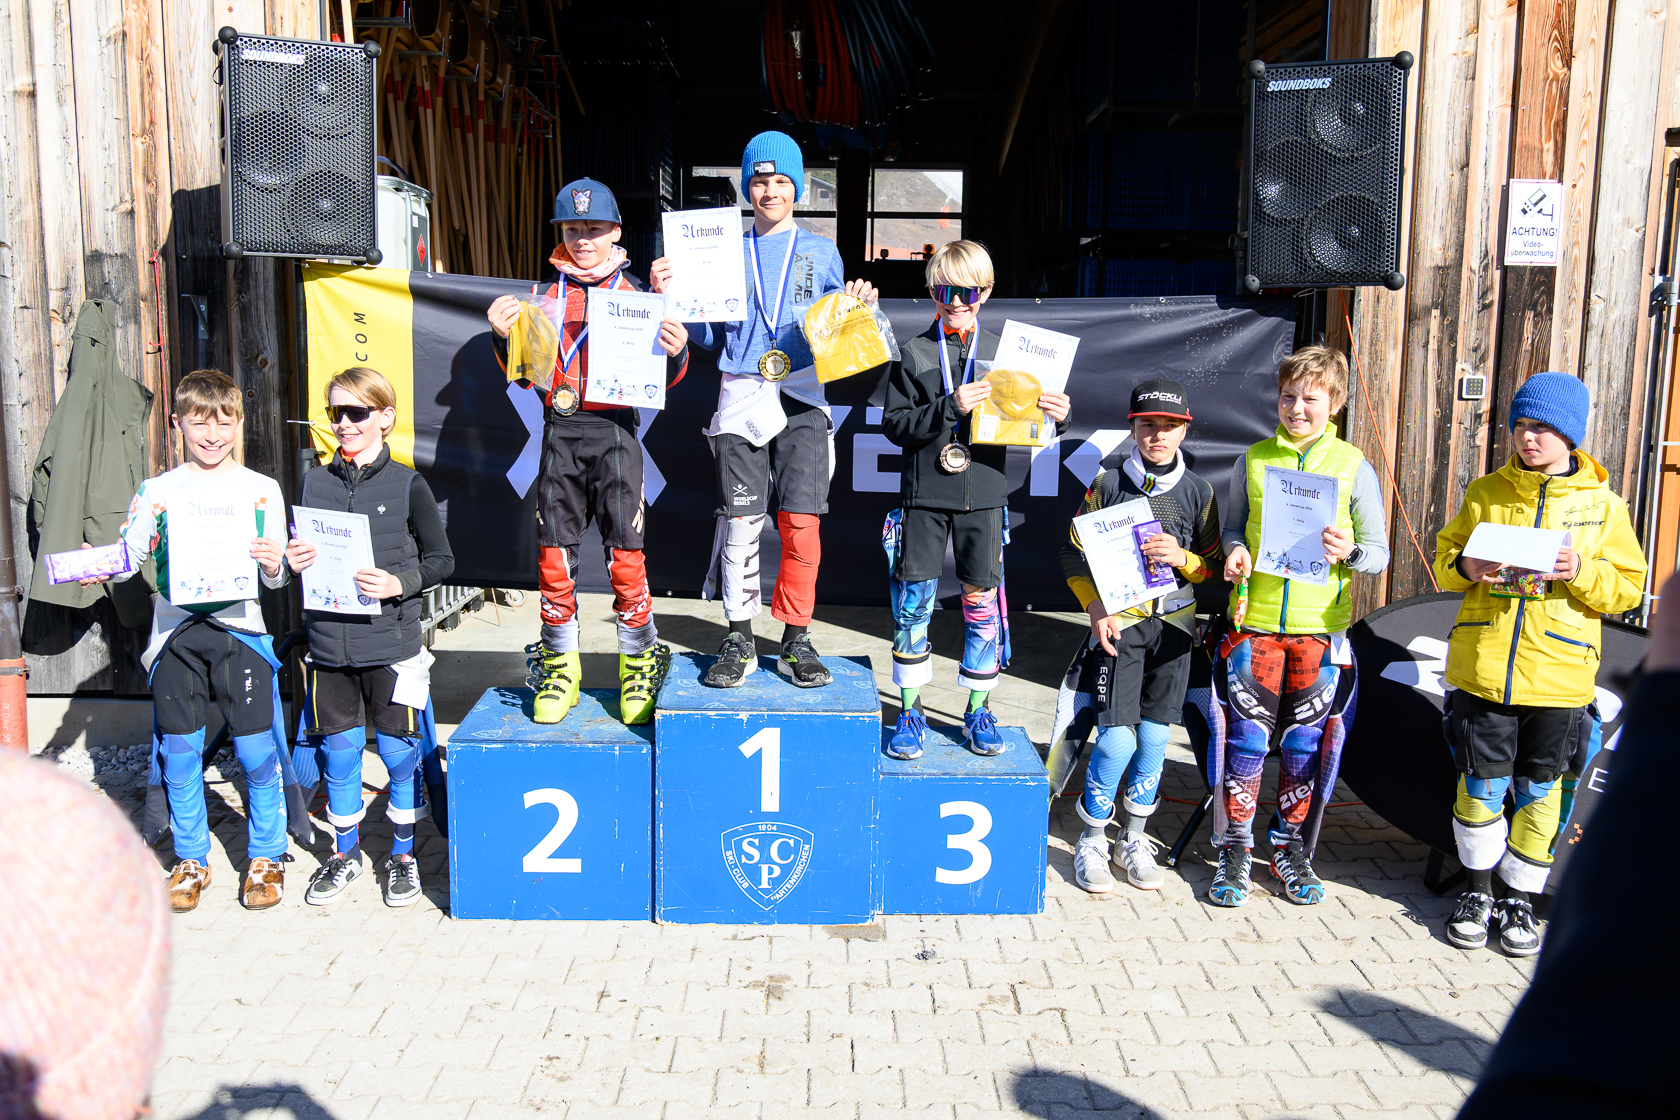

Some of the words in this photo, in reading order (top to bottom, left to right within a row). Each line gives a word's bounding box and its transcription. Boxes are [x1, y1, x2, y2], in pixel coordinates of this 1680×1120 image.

[241, 49, 306, 65] SOUNDBOKS
[1267, 78, 1332, 91] SOUNDBOKS
[681, 224, 724, 238] Urkunde
[1511, 226, 1558, 237] ACHTUNG!
[1523, 240, 1544, 248] Video-
[1510, 249, 1554, 259] überwachung
[794, 253, 803, 304] ARMO
[804, 253, 814, 299] UNDE
[607, 301, 651, 320] Urkunde
[1018, 336, 1058, 359] Urkunde
[1280, 479, 1321, 500] Urkunde
[188, 502, 235, 517] Urkunde
[312, 519, 352, 538] Urkunde
[1093, 516, 1136, 533] Urkunde
[1098, 666, 1109, 703] EQPE
[738, 727, 780, 813] 1
[1225, 779, 1257, 810] ner
[522, 788, 582, 873] 2
[757, 824, 778, 832] 1904
[935, 801, 993, 885] 3
[770, 844, 811, 901] PARTENKIRCHEN
